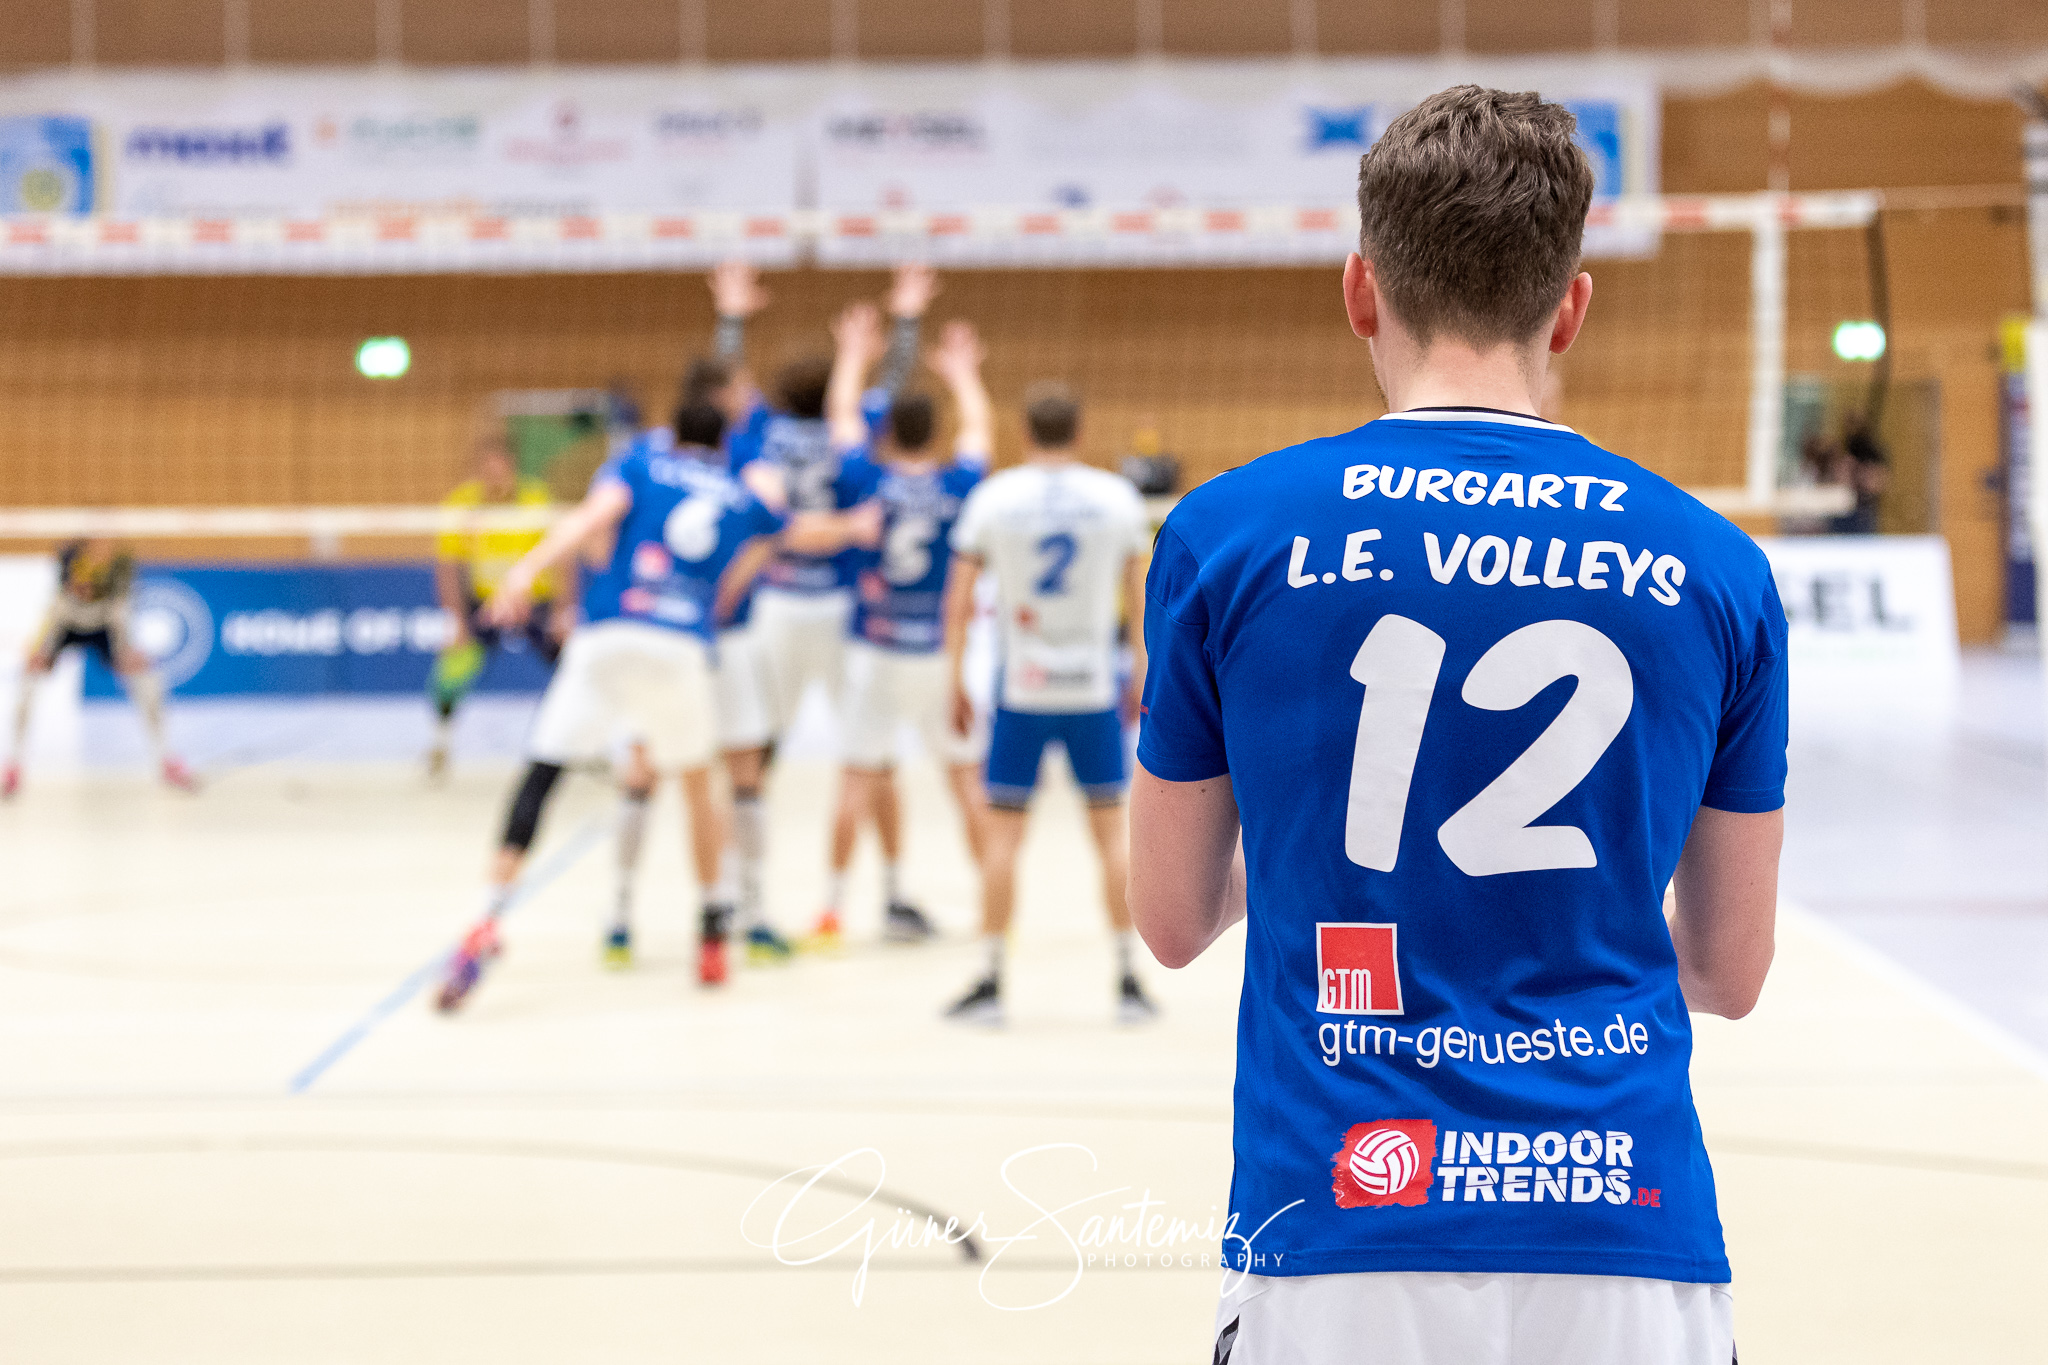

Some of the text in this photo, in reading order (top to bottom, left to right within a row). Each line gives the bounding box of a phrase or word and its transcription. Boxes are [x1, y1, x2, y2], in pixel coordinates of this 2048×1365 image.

[1342, 464, 1629, 512] BURGARTZ
[664, 495, 721, 562] 6
[1034, 531, 1078, 597] 2
[1287, 529, 1687, 606] L.E. VOLLEYS
[1344, 613, 1634, 878] 12
[1322, 968, 1372, 1011] GTM
[1318, 1014, 1649, 1069] gtm-gerueste.de
[1441, 1130, 1634, 1167] INDOOR
